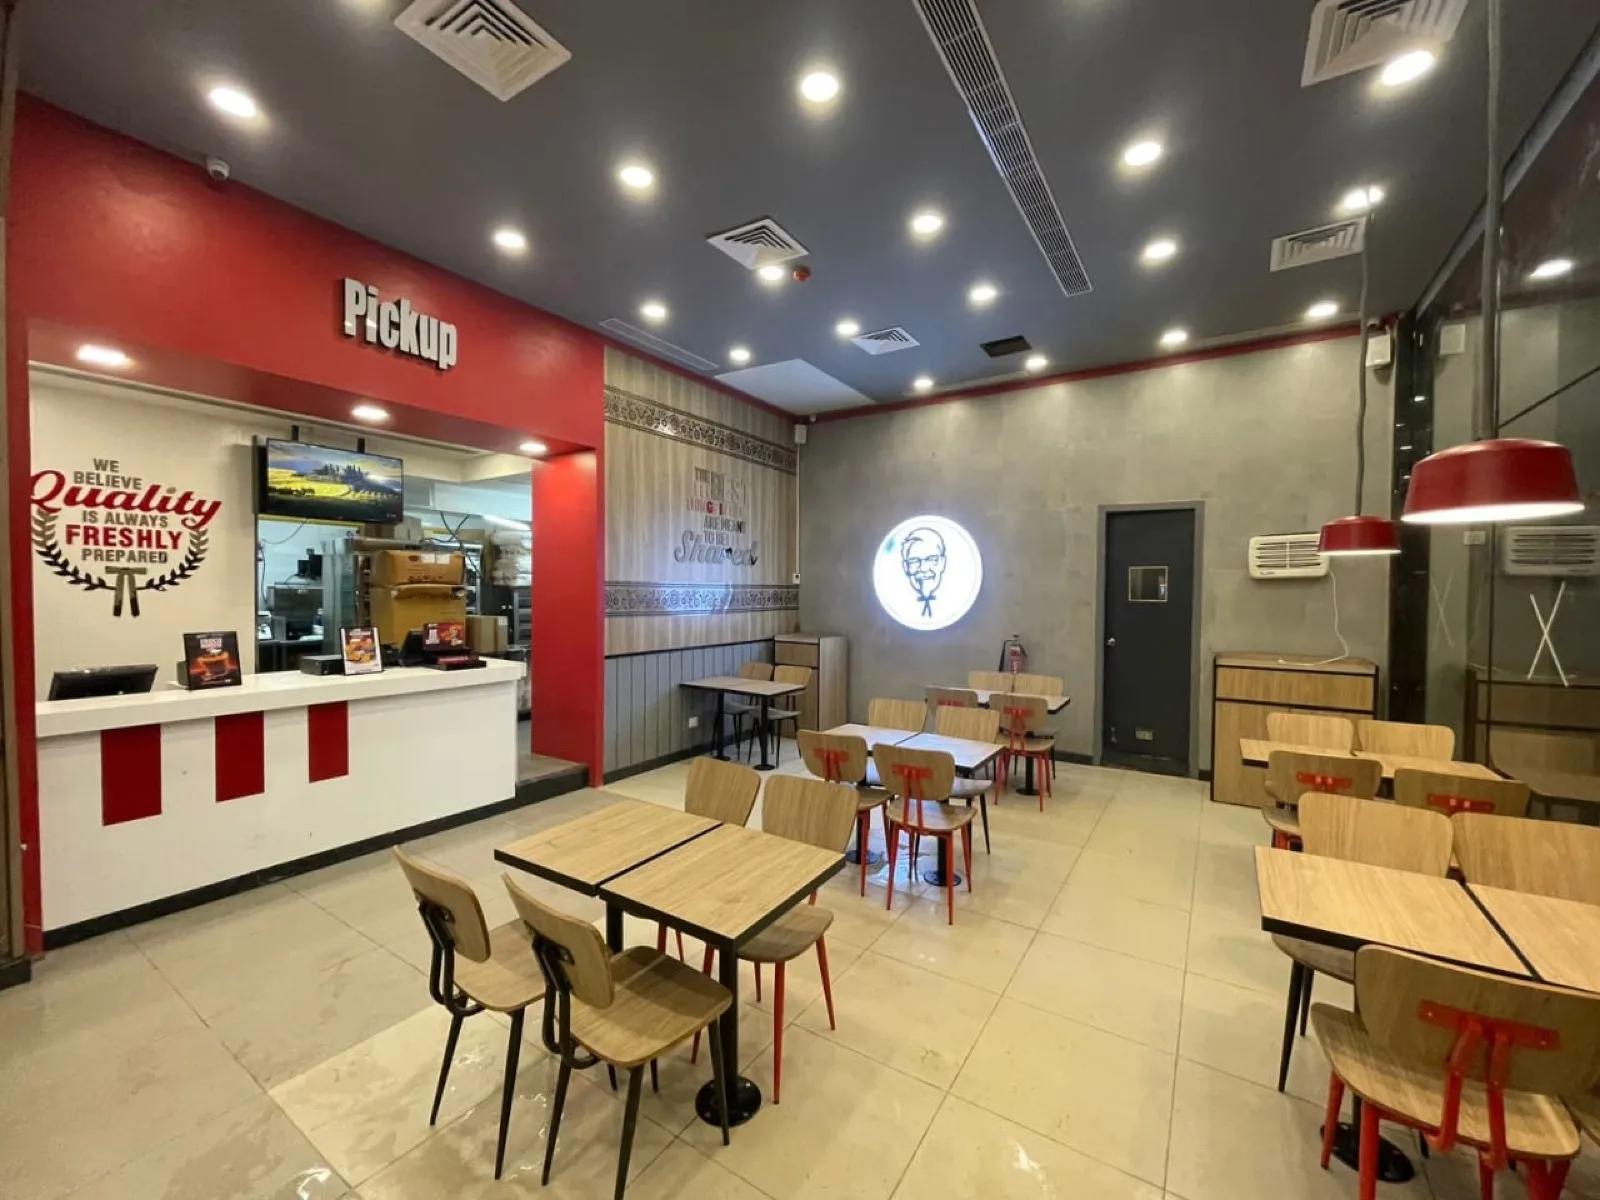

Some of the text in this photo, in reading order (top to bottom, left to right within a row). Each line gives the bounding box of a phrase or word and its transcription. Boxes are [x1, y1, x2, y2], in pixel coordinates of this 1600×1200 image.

[344, 276, 457, 370] Pickup
[93, 457, 120, 473] WE
[73, 471, 142, 490] BELIEVE
[30, 469, 223, 530] Quality
[82, 510, 169, 528] IS ALWAYS
[65, 524, 183, 550] FRESHLY
[81, 548, 169, 564] PREPARED
